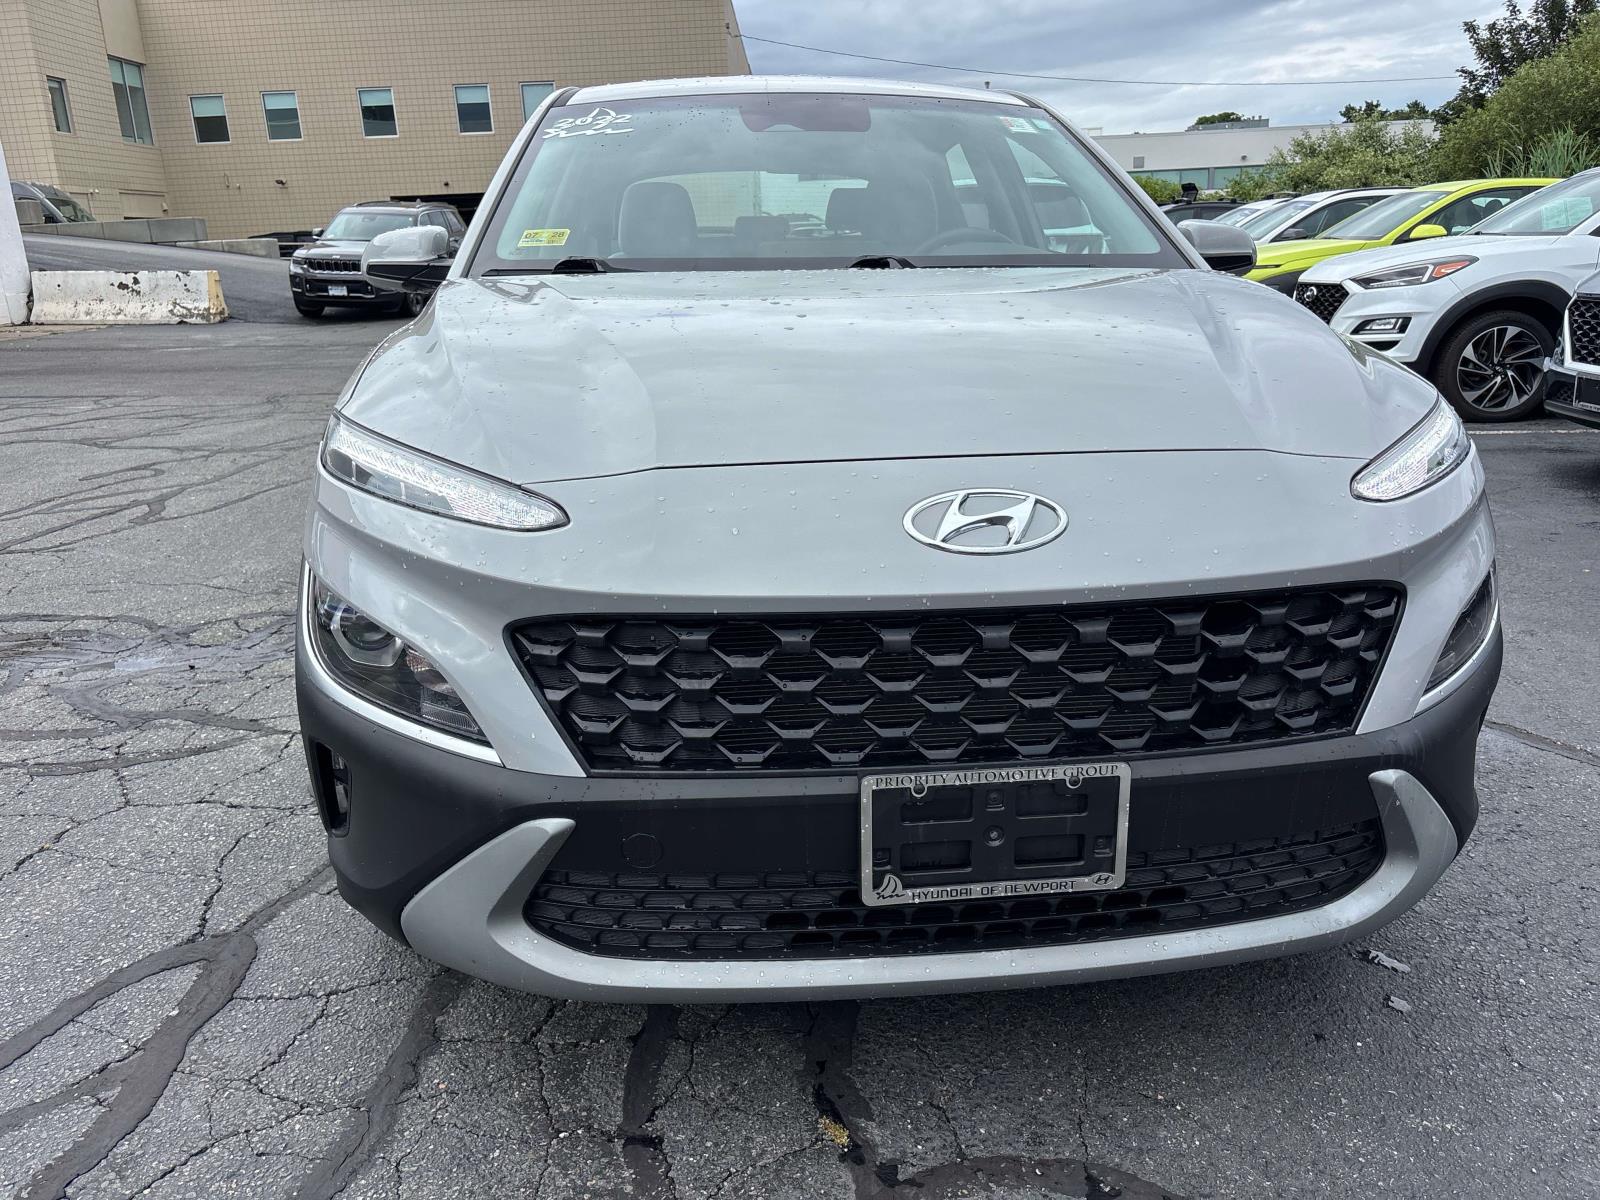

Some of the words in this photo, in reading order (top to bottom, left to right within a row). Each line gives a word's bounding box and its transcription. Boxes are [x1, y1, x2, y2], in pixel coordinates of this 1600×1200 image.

[875, 774, 949, 788] PRIORITY
[953, 768, 1058, 783] AUTOMOTIVE
[1063, 764, 1118, 777] GROUP
[912, 888, 972, 901] HYUNDAI
[980, 885, 1000, 896] OF
[1004, 880, 1077, 895] NEWPORT
